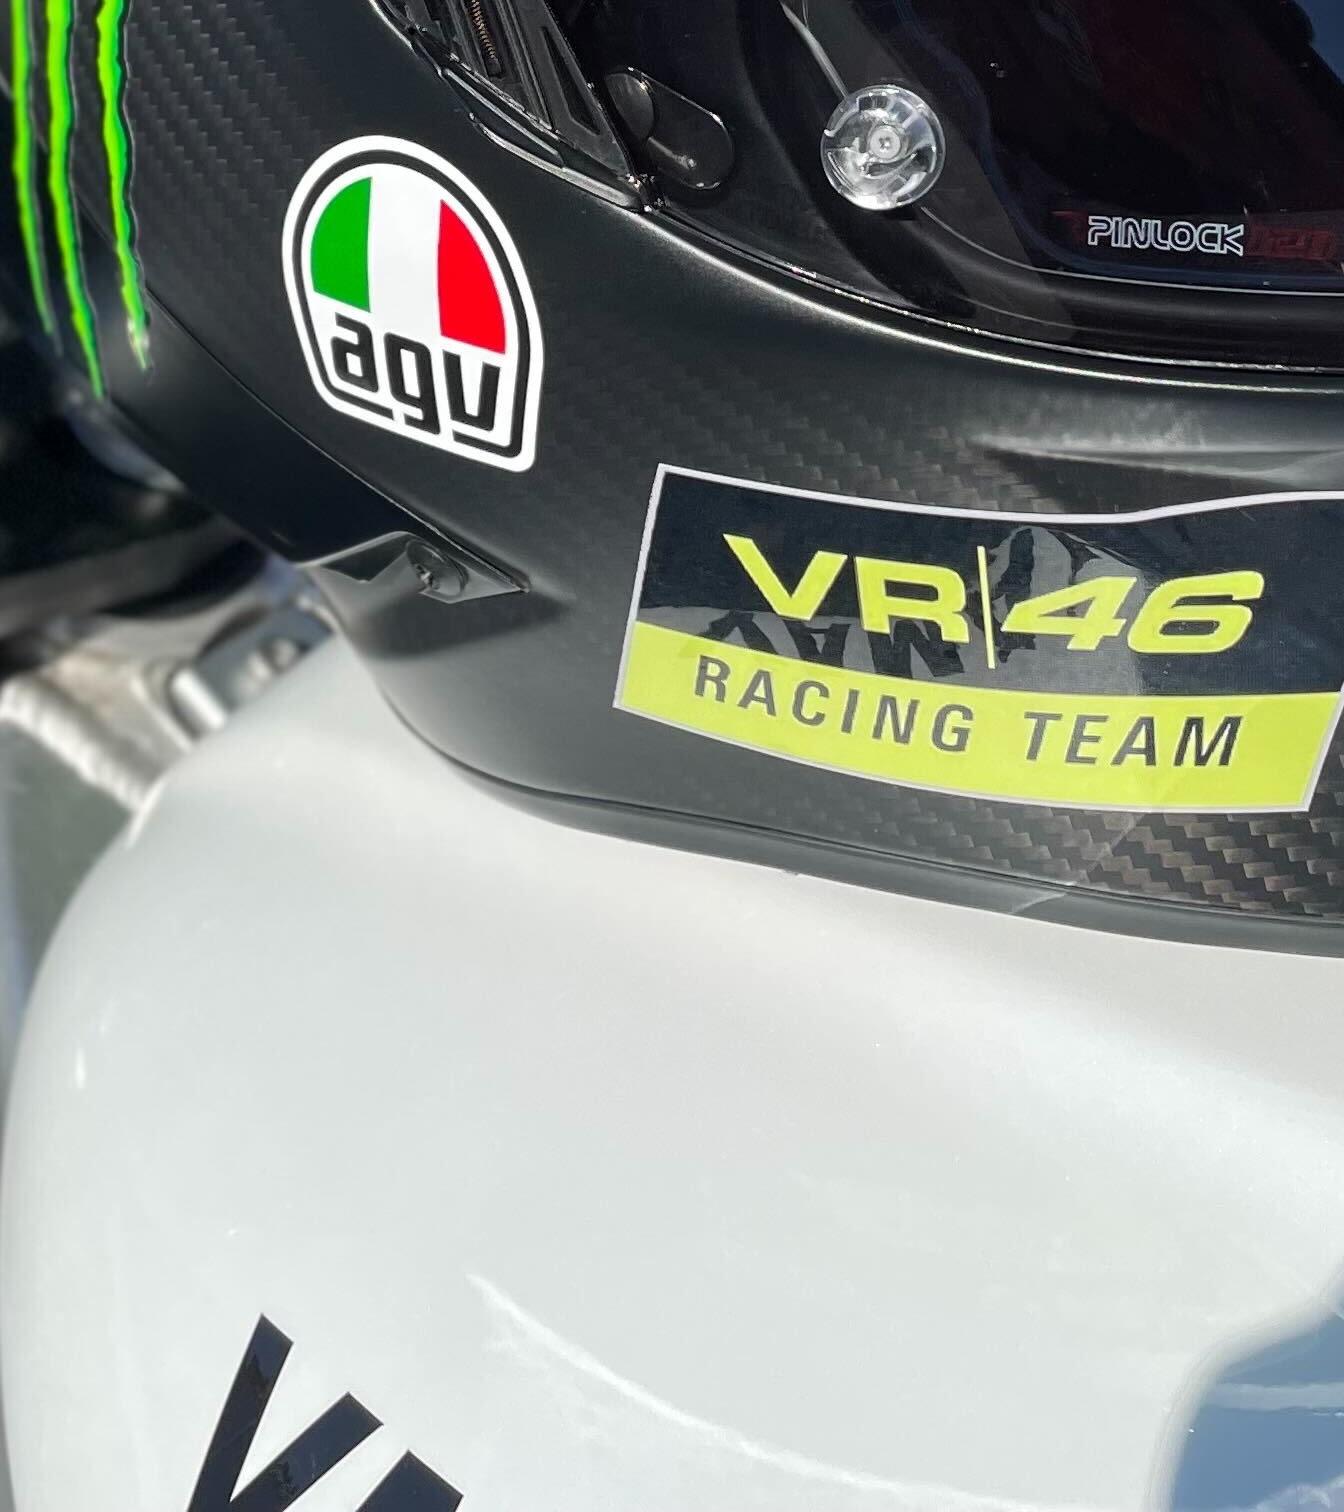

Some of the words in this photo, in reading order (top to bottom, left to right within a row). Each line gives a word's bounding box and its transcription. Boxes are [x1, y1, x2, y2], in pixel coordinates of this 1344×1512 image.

[1087, 215, 1245, 257] PINLOCK
[330, 311, 501, 435] agv
[694, 654, 975, 754] RACING
[1023, 711, 1244, 768] TEAM
